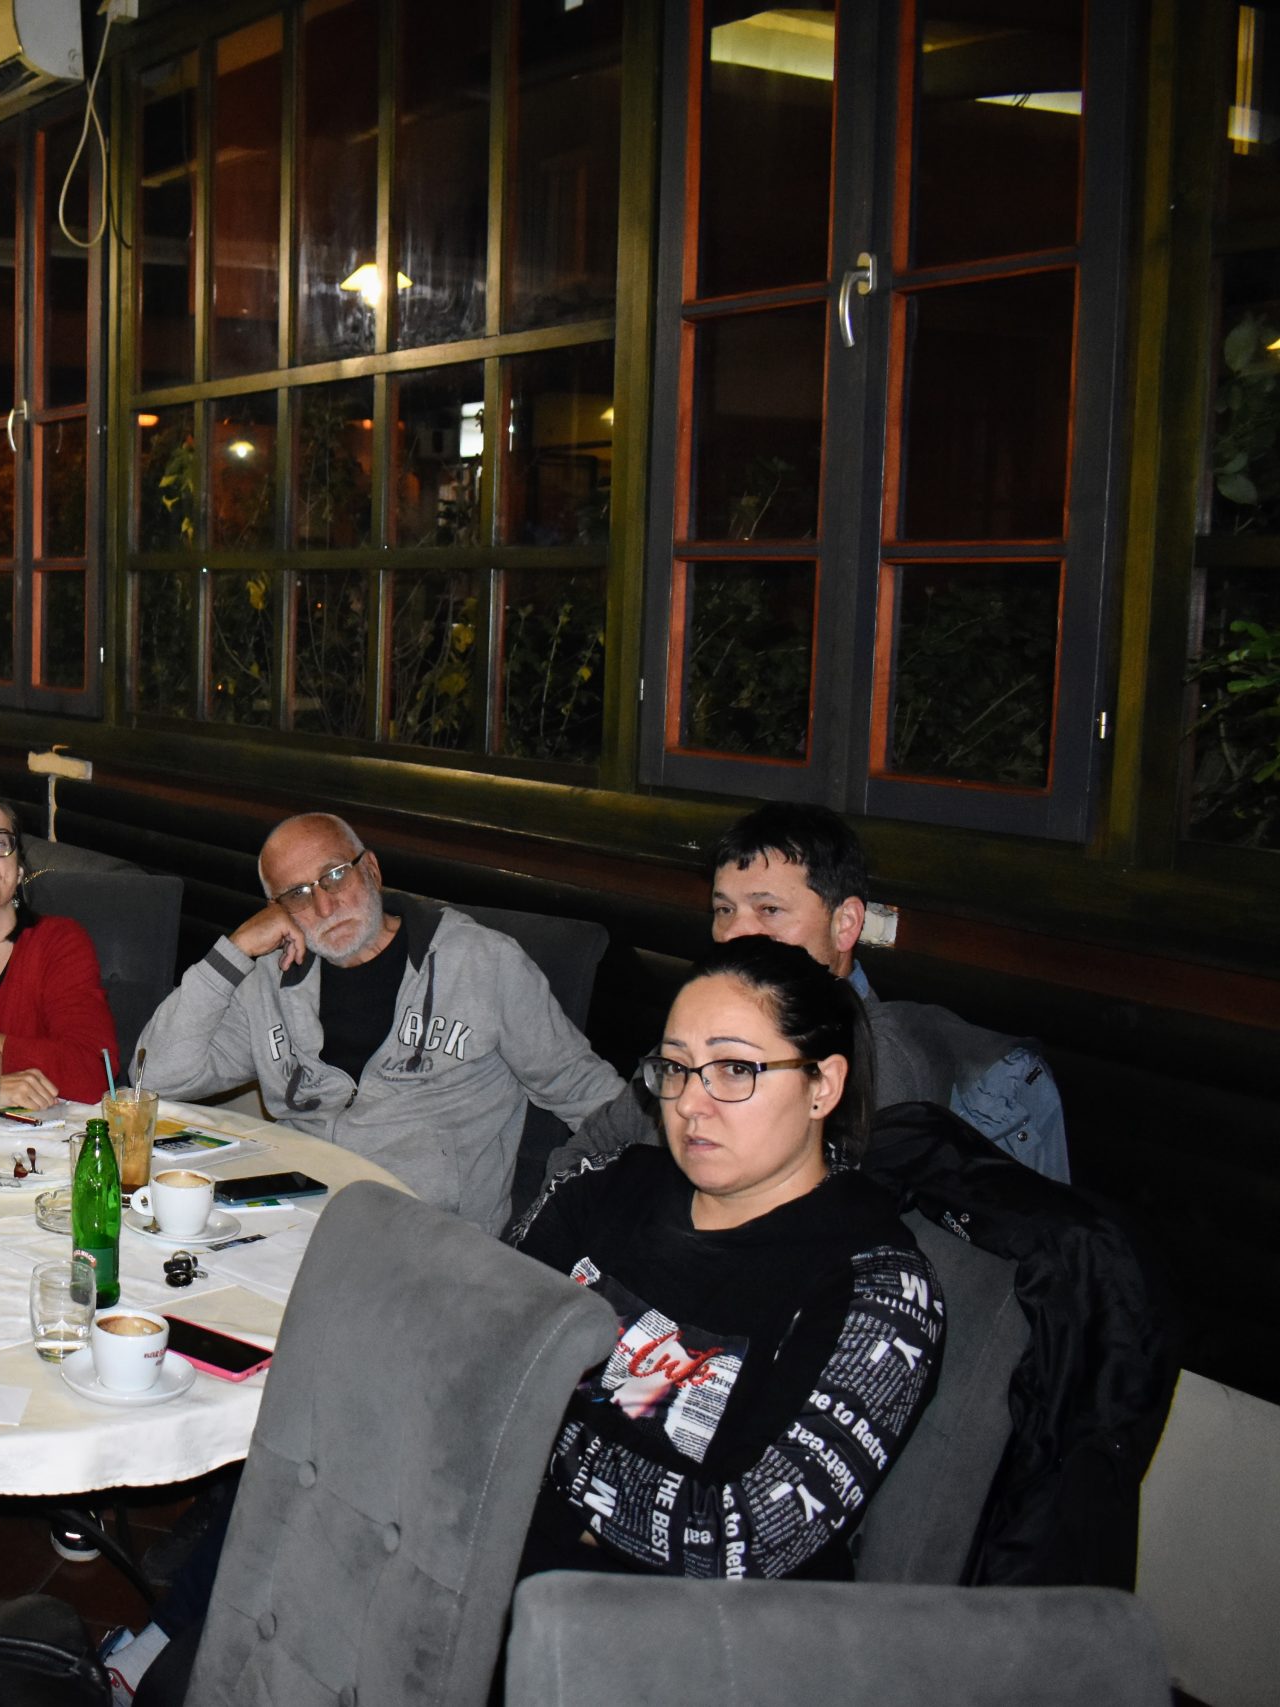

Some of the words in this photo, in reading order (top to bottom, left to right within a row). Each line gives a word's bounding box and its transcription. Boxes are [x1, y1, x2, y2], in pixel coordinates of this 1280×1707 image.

[398, 1006, 473, 1061] ACK
[833, 1401, 854, 1425] to
[655, 1471, 685, 1510] THE
[651, 1509, 671, 1562] BEST
[724, 1512, 741, 1538] to
